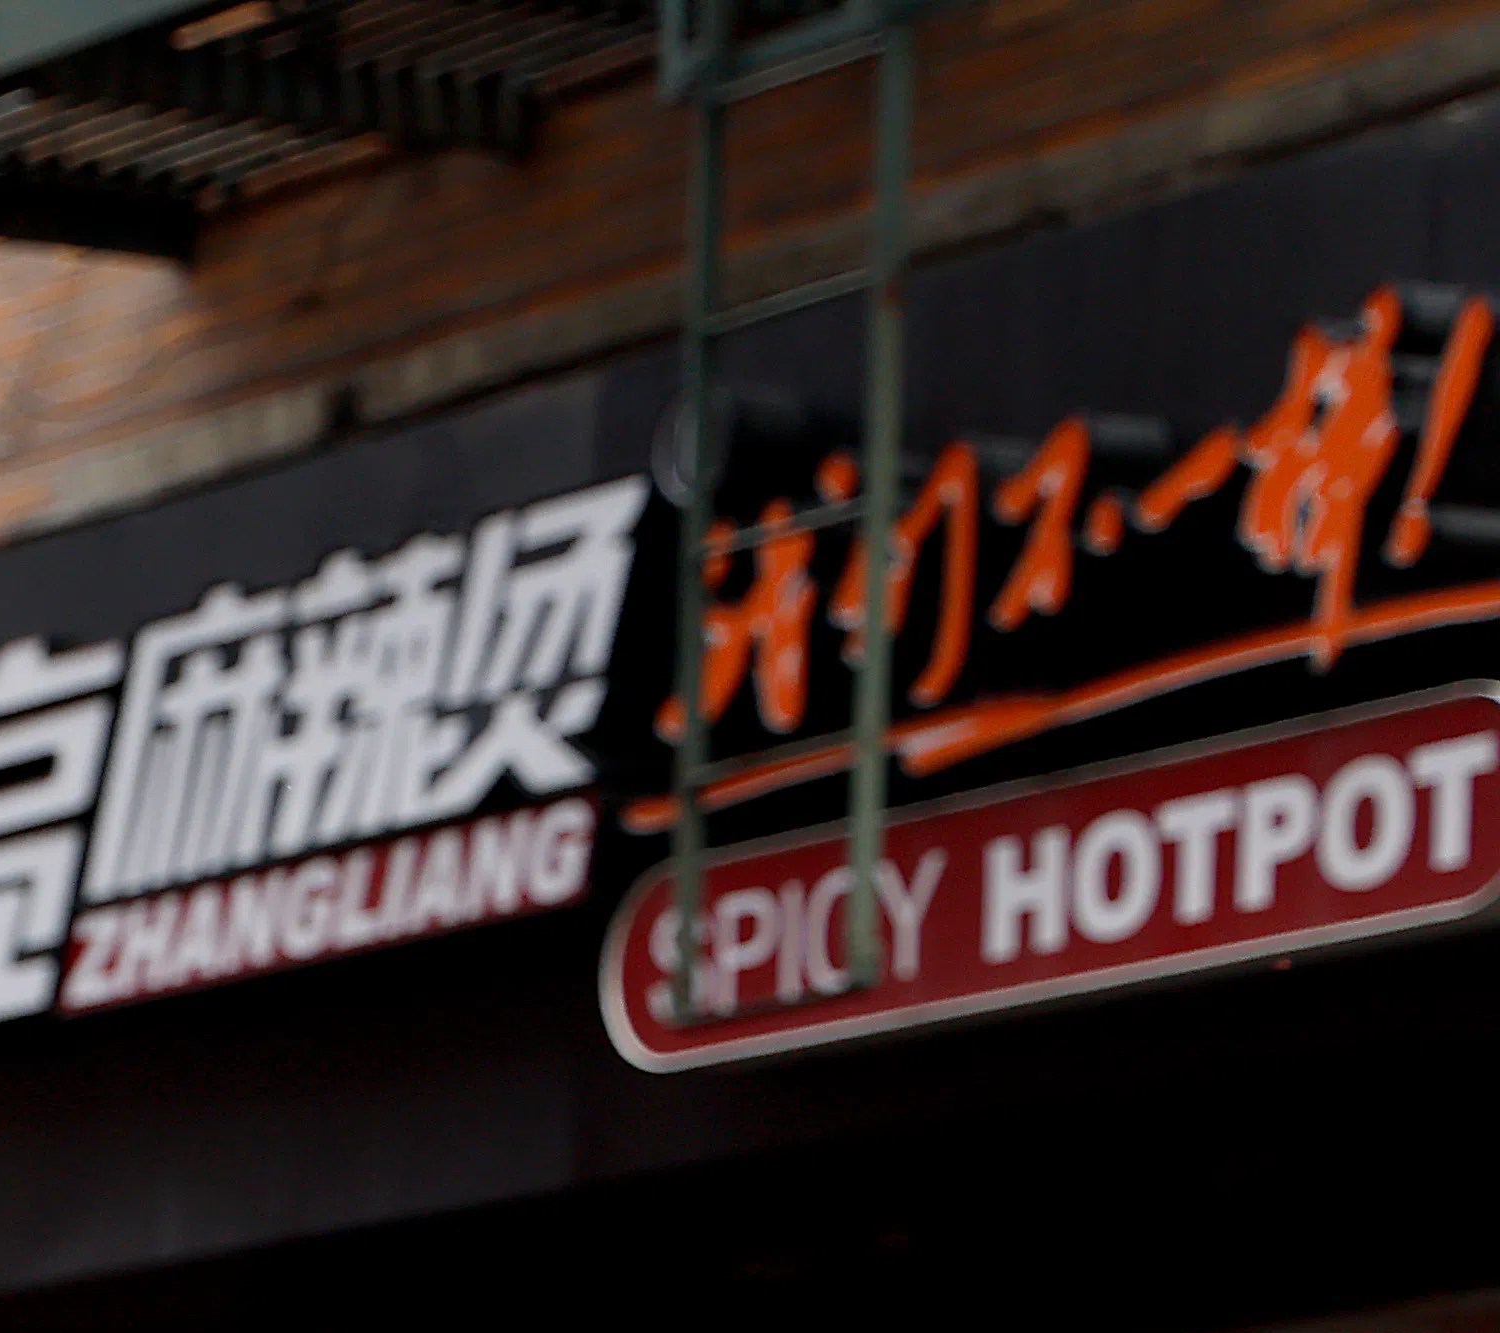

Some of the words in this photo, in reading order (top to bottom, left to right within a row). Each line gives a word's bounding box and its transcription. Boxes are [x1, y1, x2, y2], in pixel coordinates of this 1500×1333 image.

[63, 806, 595, 1009] ZHANGLIANG
[646, 847, 946, 1018] SPICY
[979, 731, 1499, 964] HOTPOT
